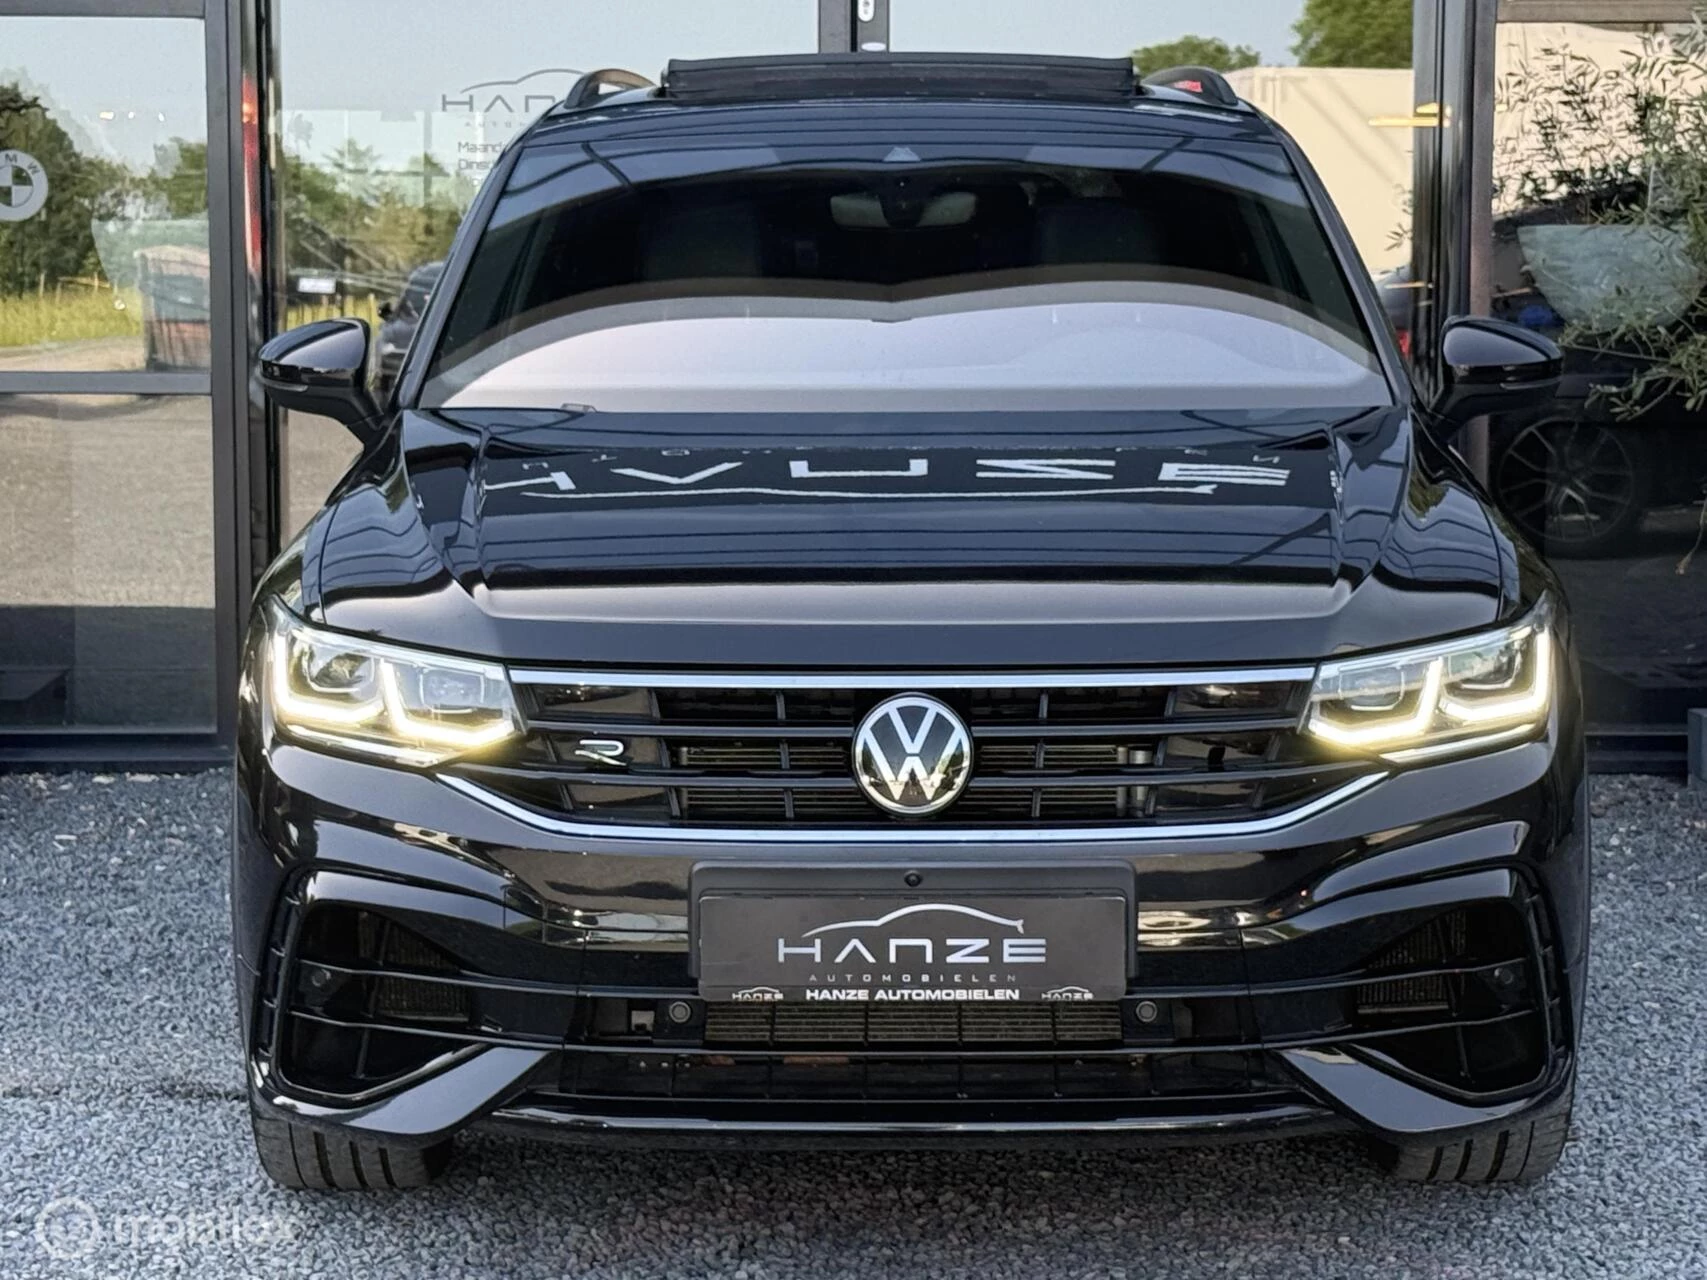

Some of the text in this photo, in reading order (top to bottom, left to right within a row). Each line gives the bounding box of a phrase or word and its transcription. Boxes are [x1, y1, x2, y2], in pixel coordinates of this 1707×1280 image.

[442, 94, 556, 112] HAN
[778, 938, 1046, 963] HANZE
[808, 974, 1016, 982] AUTOMOBIELEN
[806, 989, 1019, 1001] HANZE AUTOMOBIELEN
